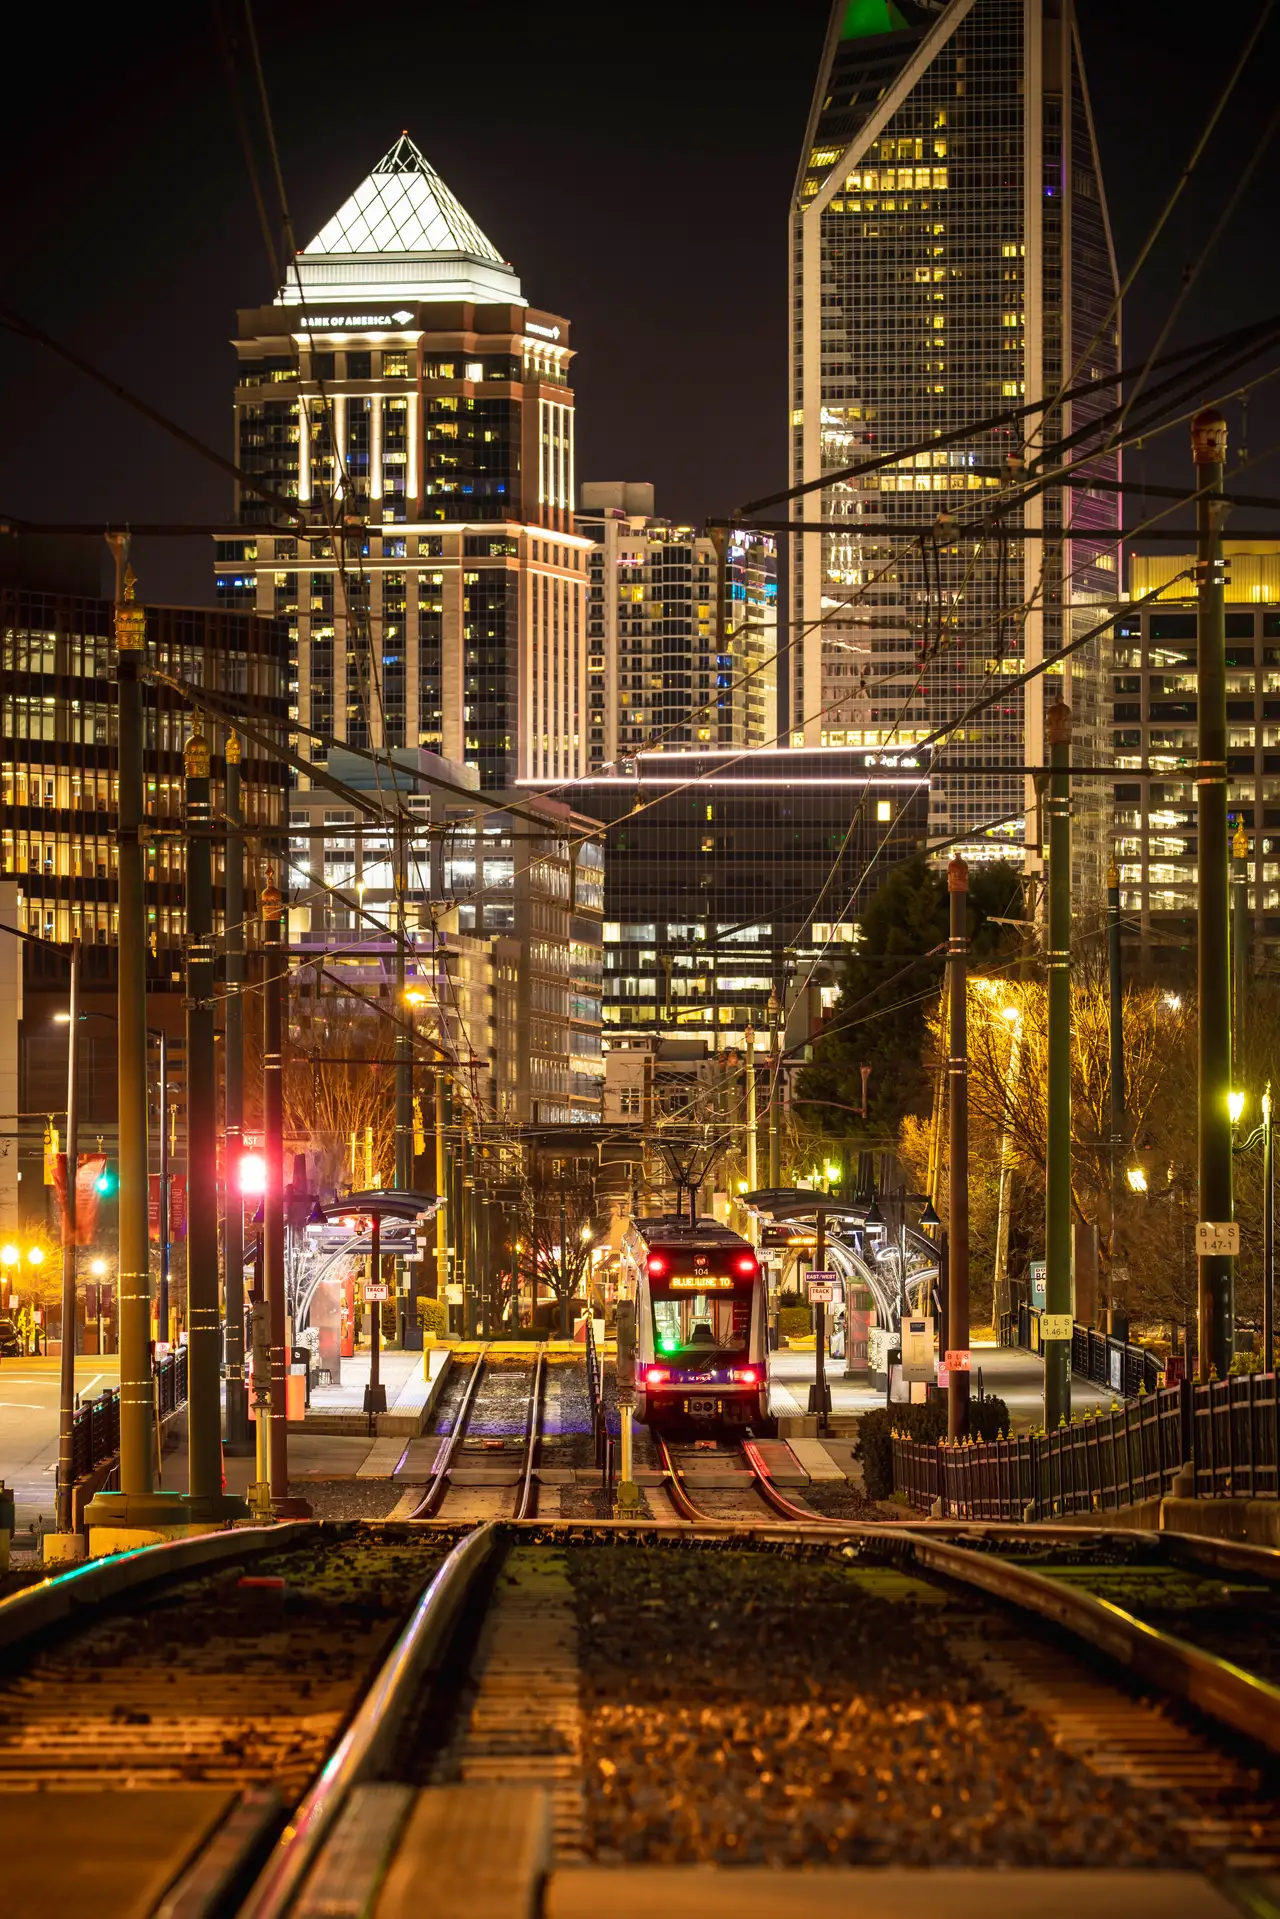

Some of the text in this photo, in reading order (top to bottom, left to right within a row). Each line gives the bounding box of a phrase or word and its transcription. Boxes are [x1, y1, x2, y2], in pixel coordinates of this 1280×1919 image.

[301, 315, 392, 327] BANK OF AMERICA
[694, 1268, 709, 1276] 104
[719, 1277, 731, 1287] TO
